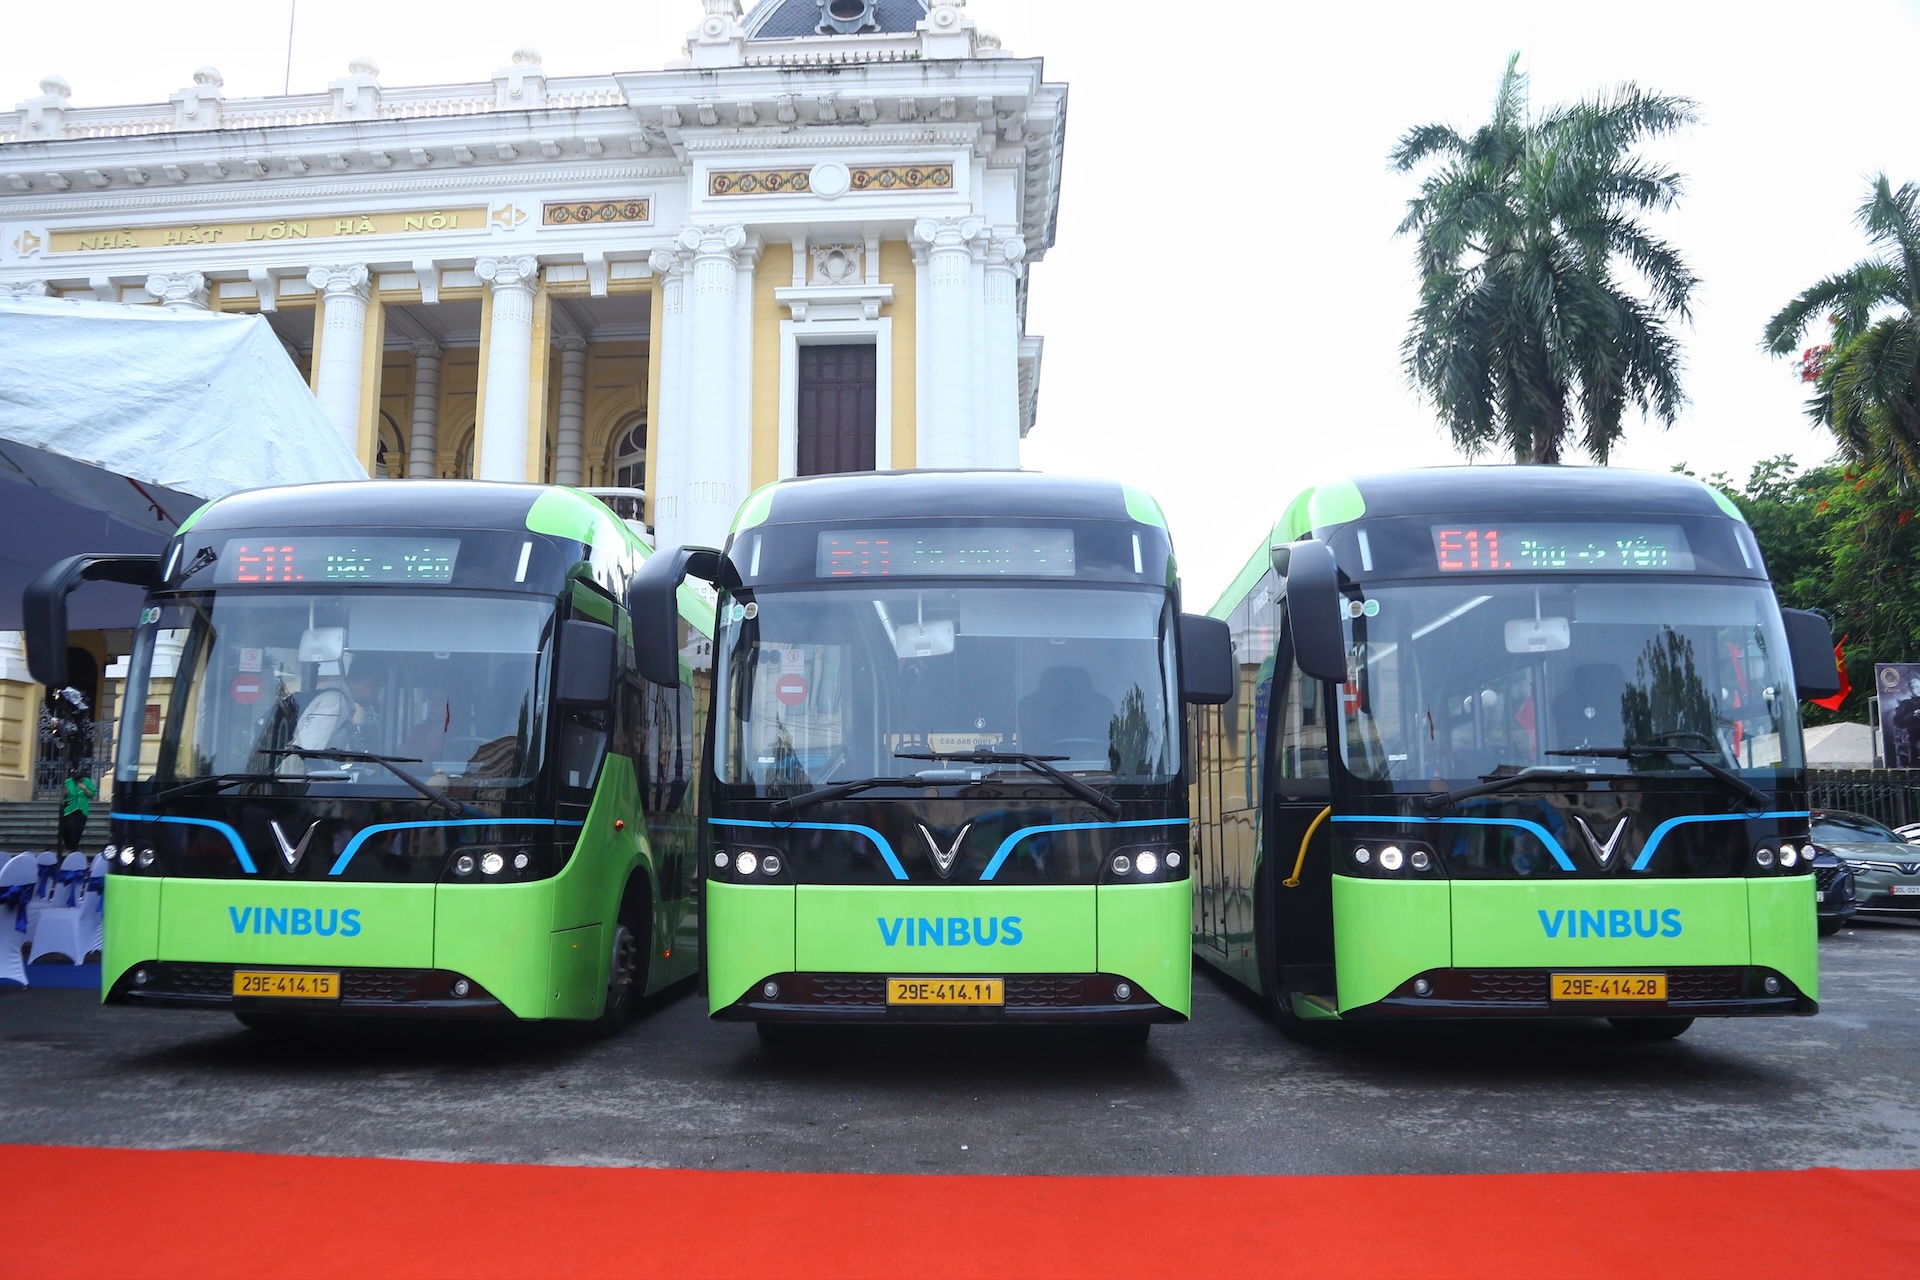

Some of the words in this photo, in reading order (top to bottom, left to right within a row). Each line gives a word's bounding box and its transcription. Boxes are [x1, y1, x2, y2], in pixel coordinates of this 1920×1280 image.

[78, 229, 139, 250] NHÀ
[163, 225, 222, 246] HÁT
[245, 220, 308, 241] LỚN
[334, 215, 377, 235] HÀ
[404, 211, 458, 231] NỘI
[228, 906, 362, 937] VINBUS
[877, 915, 1023, 947] VINBUS
[1537, 908, 1683, 939] VINBUS
[242, 976, 330, 994] 29E-414.15
[898, 984, 992, 1000] 29E-414.11
[1562, 979, 1657, 996] 29E-414.28
